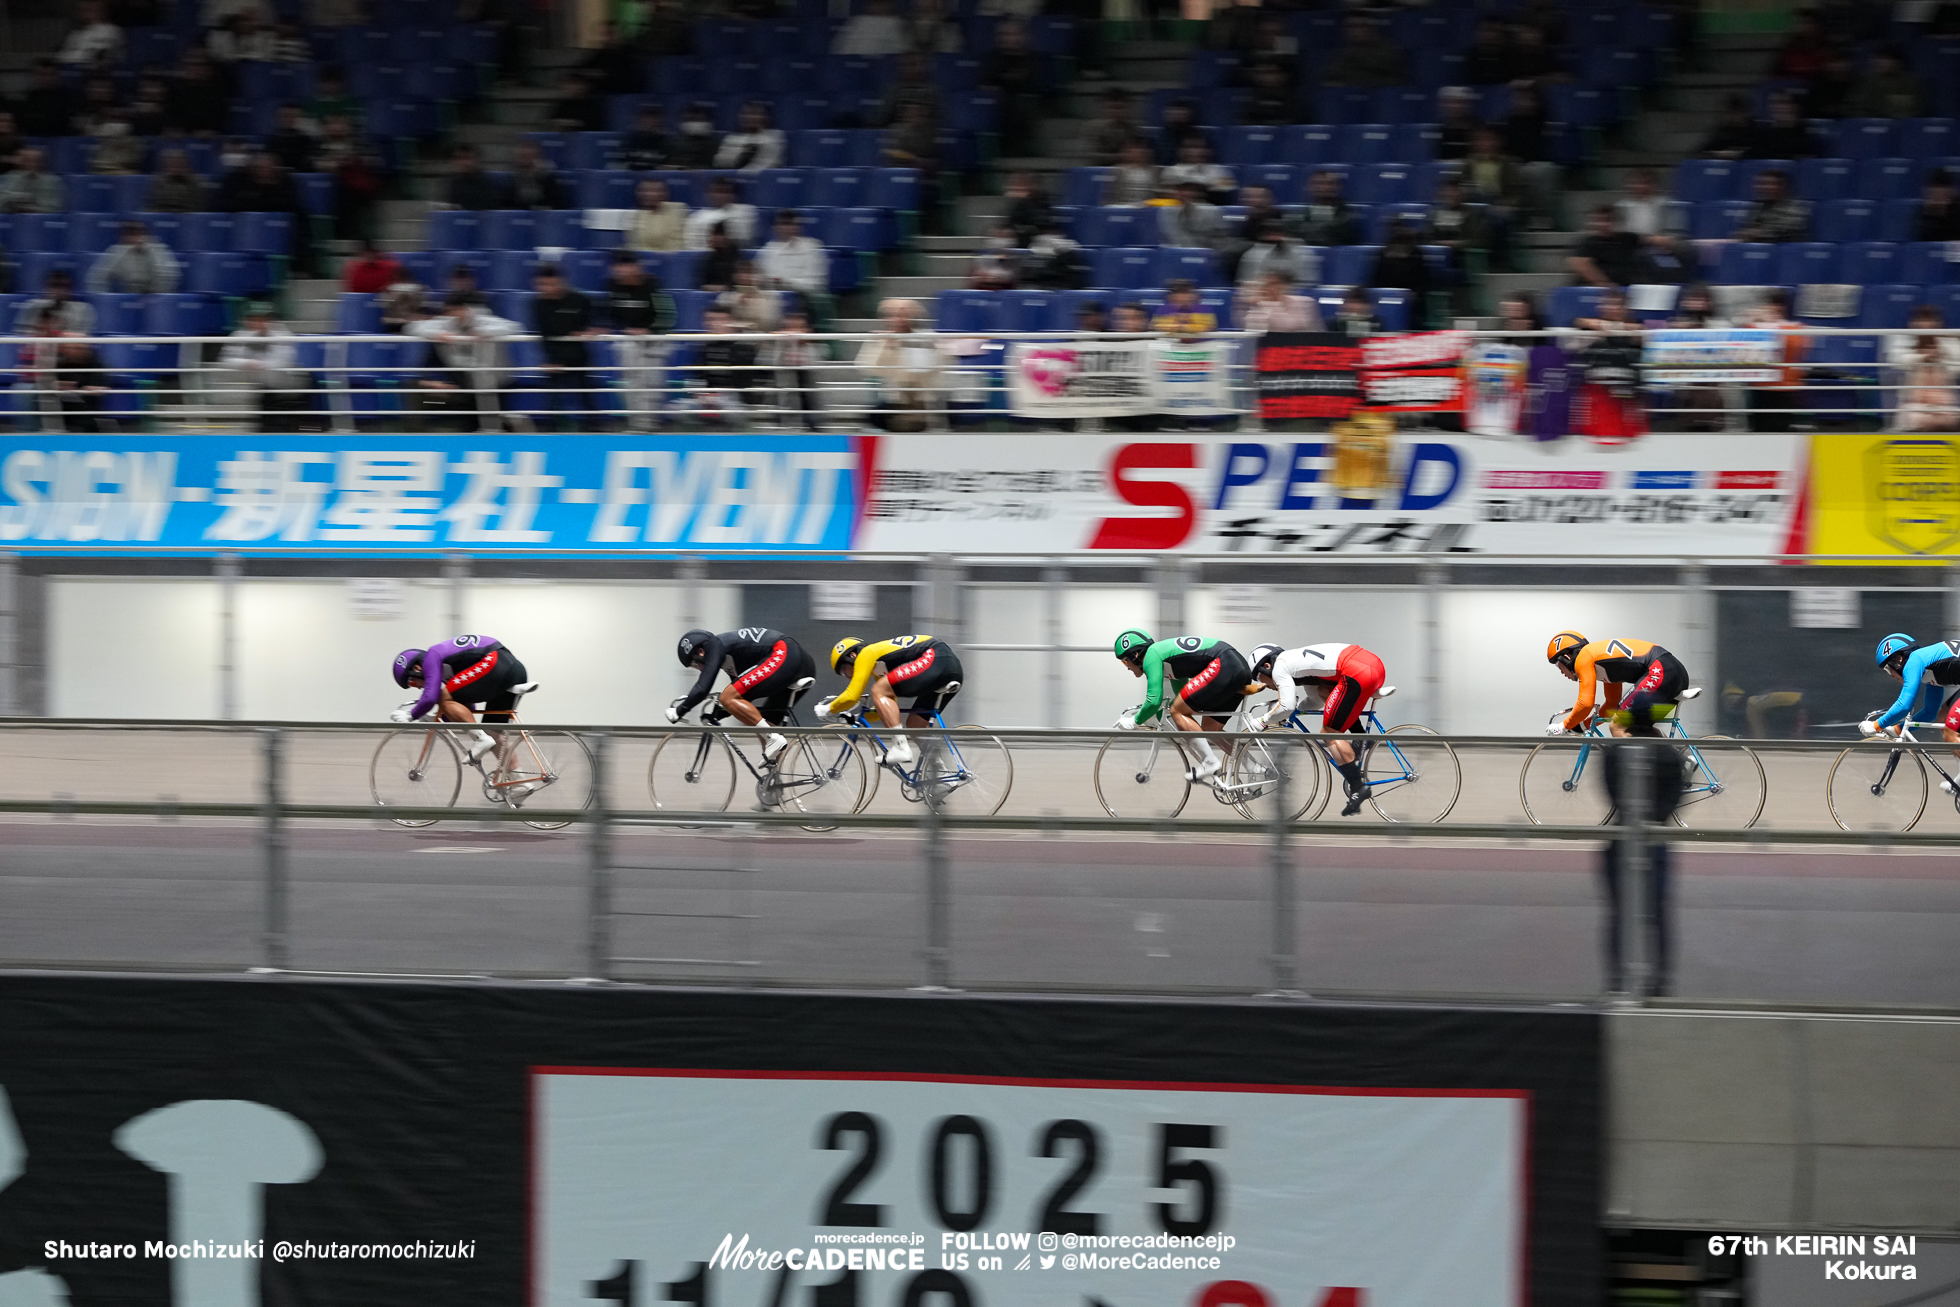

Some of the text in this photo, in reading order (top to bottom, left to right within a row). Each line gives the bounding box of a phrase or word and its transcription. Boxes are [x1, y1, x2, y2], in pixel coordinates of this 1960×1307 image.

[1090, 443, 1462, 549] SPED
[737, 626, 768, 644] 2
[1120, 633, 1131, 650] 6
[1174, 635, 1203, 653] 6
[1553, 636, 1563, 652] 7
[1605, 638, 1634, 660] 7
[1882, 640, 1893, 657] 4
[1325, 687, 1340, 715] KEIRIN
[814, 1111, 1228, 1239] 2025
